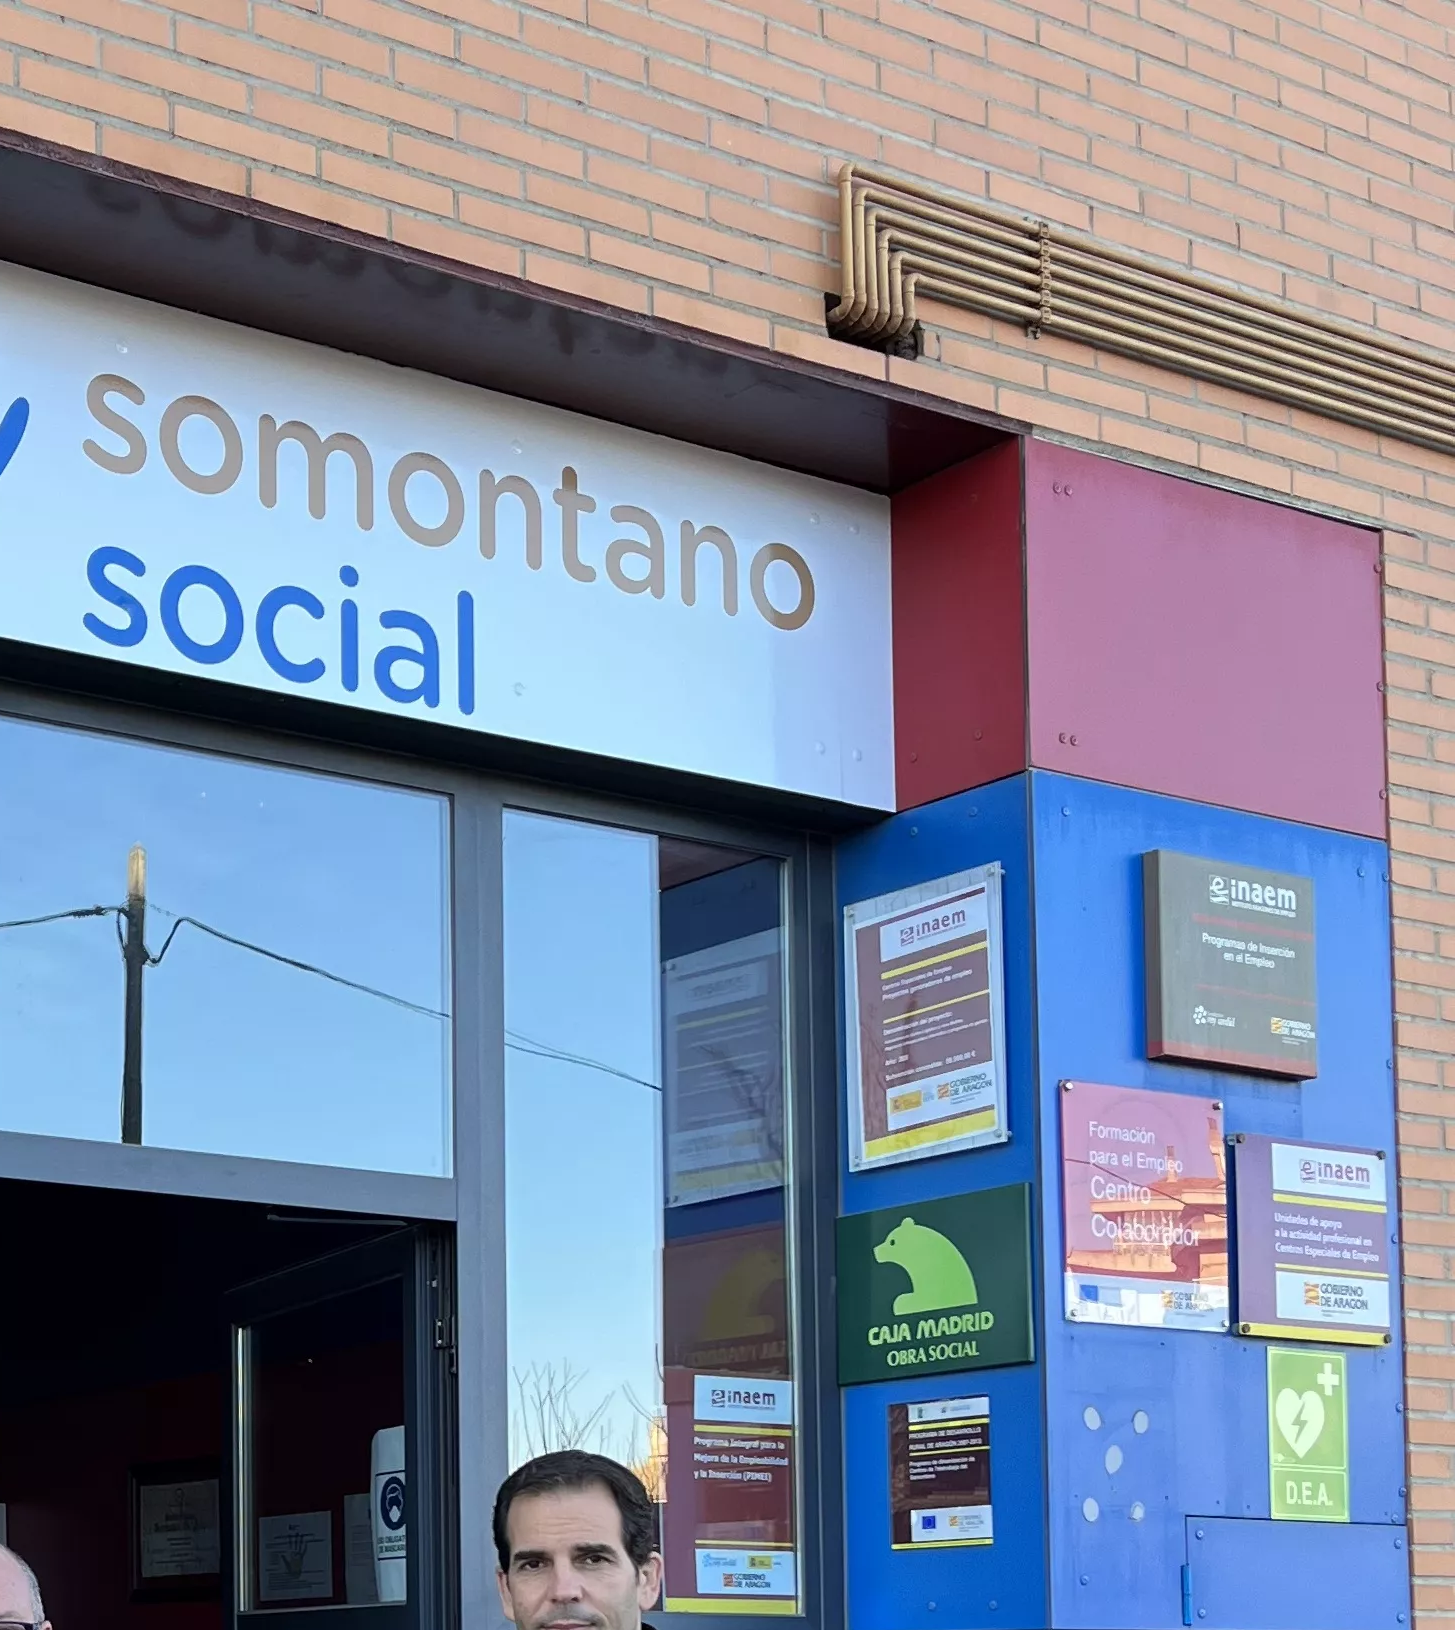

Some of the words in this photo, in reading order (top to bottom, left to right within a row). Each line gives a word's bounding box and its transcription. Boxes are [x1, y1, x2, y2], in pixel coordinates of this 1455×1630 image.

[83, 373, 816, 631] somontano
[83, 545, 475, 716] social
[1230, 878, 1297, 910] inaem
[916, 909, 966, 937] inaem
[1202, 932, 1246, 950] Programas
[1247, 941, 1258, 952] de
[1223, 952, 1234, 961] en
[1235, 953, 1244, 963] el
[1244, 954, 1276, 968] Empleo
[1088, 1121, 1156, 1145] Formación
[1089, 1150, 1119, 1168] para
[1122, 1151, 1134, 1168] el
[1136, 1152, 1184, 1175] Empleo
[1317, 1161, 1371, 1183] inaem
[1090, 1175, 1152, 1205] Centro
[1091, 1213, 1201, 1247] Colaborador
[1274, 1212, 1309, 1226] Unidades
[1309, 1215, 1319, 1227] de
[1319, 1219, 1343, 1231] apoyo
[1274, 1229, 1280, 1238] a
[1280, 1227, 1288, 1238] la
[1288, 1229, 1322, 1242] actividad
[1322, 1232, 1363, 1247] profesional
[1362, 1238, 1373, 1247] en
[1274, 1242, 1304, 1255] Centros
[1304, 1245, 1342, 1259] Especiales
[1341, 1248, 1351, 1260] de
[1352, 1249, 1380, 1264] Empleo
[1320, 1283, 1364, 1297] GOBIERNO
[1320, 1296, 1332, 1308] DE
[868, 1322, 912, 1346] CAJA
[916, 1311, 995, 1340] MADRID
[886, 1347, 928, 1367] OBRA
[928, 1341, 980, 1362] SOCIAL
[726, 1390, 777, 1406] inaem
[693, 1436, 730, 1448] Programa
[777, 1440, 786, 1450] la
[720, 1454, 730, 1463] de
[1286, 1480, 1334, 1506] D.E.A.
